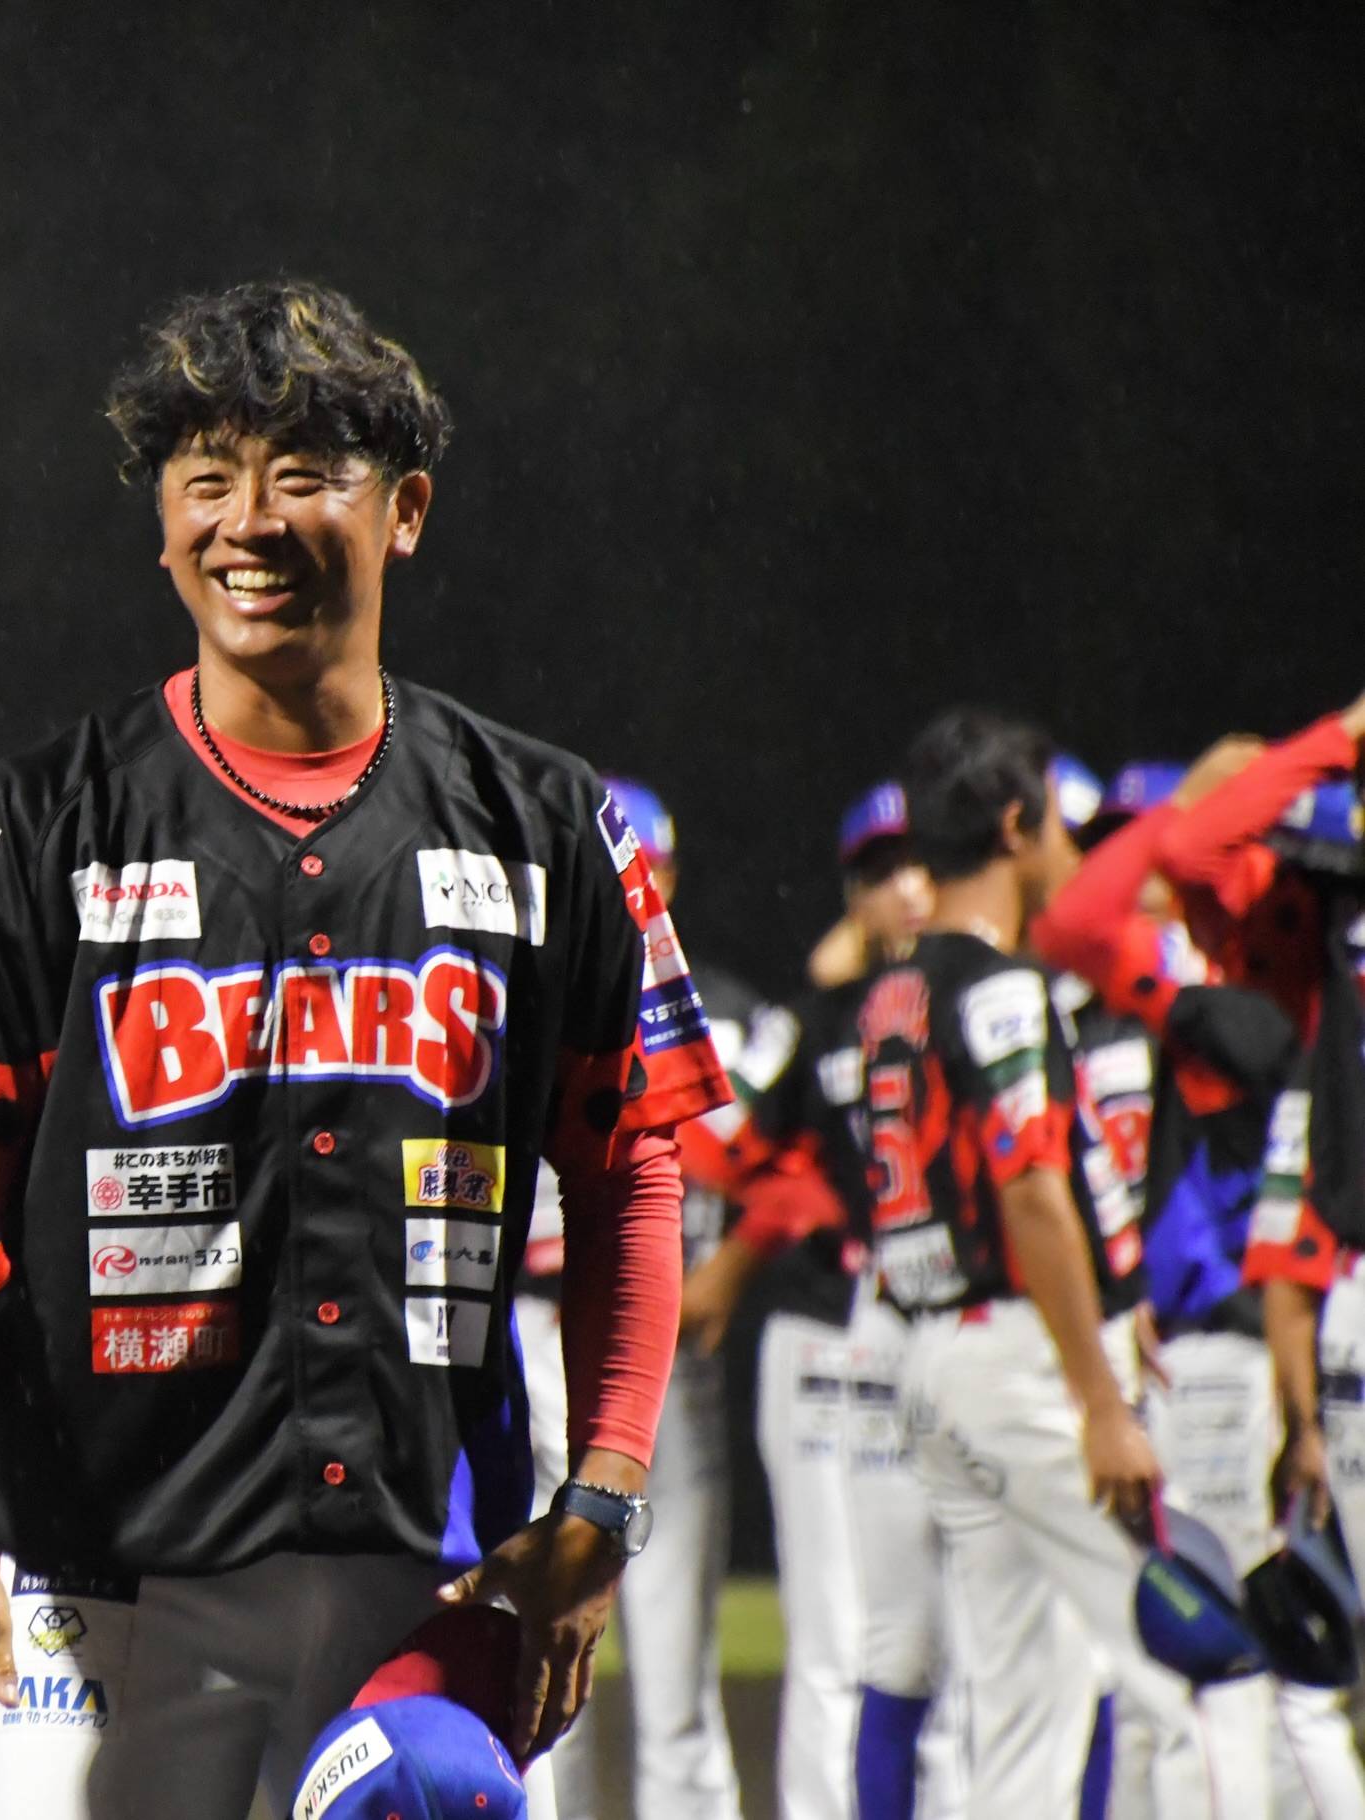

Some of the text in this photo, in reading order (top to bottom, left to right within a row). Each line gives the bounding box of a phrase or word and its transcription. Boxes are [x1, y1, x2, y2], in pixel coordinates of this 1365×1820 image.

[90, 881, 191, 902] HONDA
[97, 947, 505, 1128] BEARS
[113, 1148, 229, 1170] #このまちが好き
[127, 1171, 233, 1211] 幸手市
[104, 1326, 228, 1370] 横瀬町
[19, 1676, 109, 1714] AKA
[304, 1741, 370, 1820] DUSKIN
